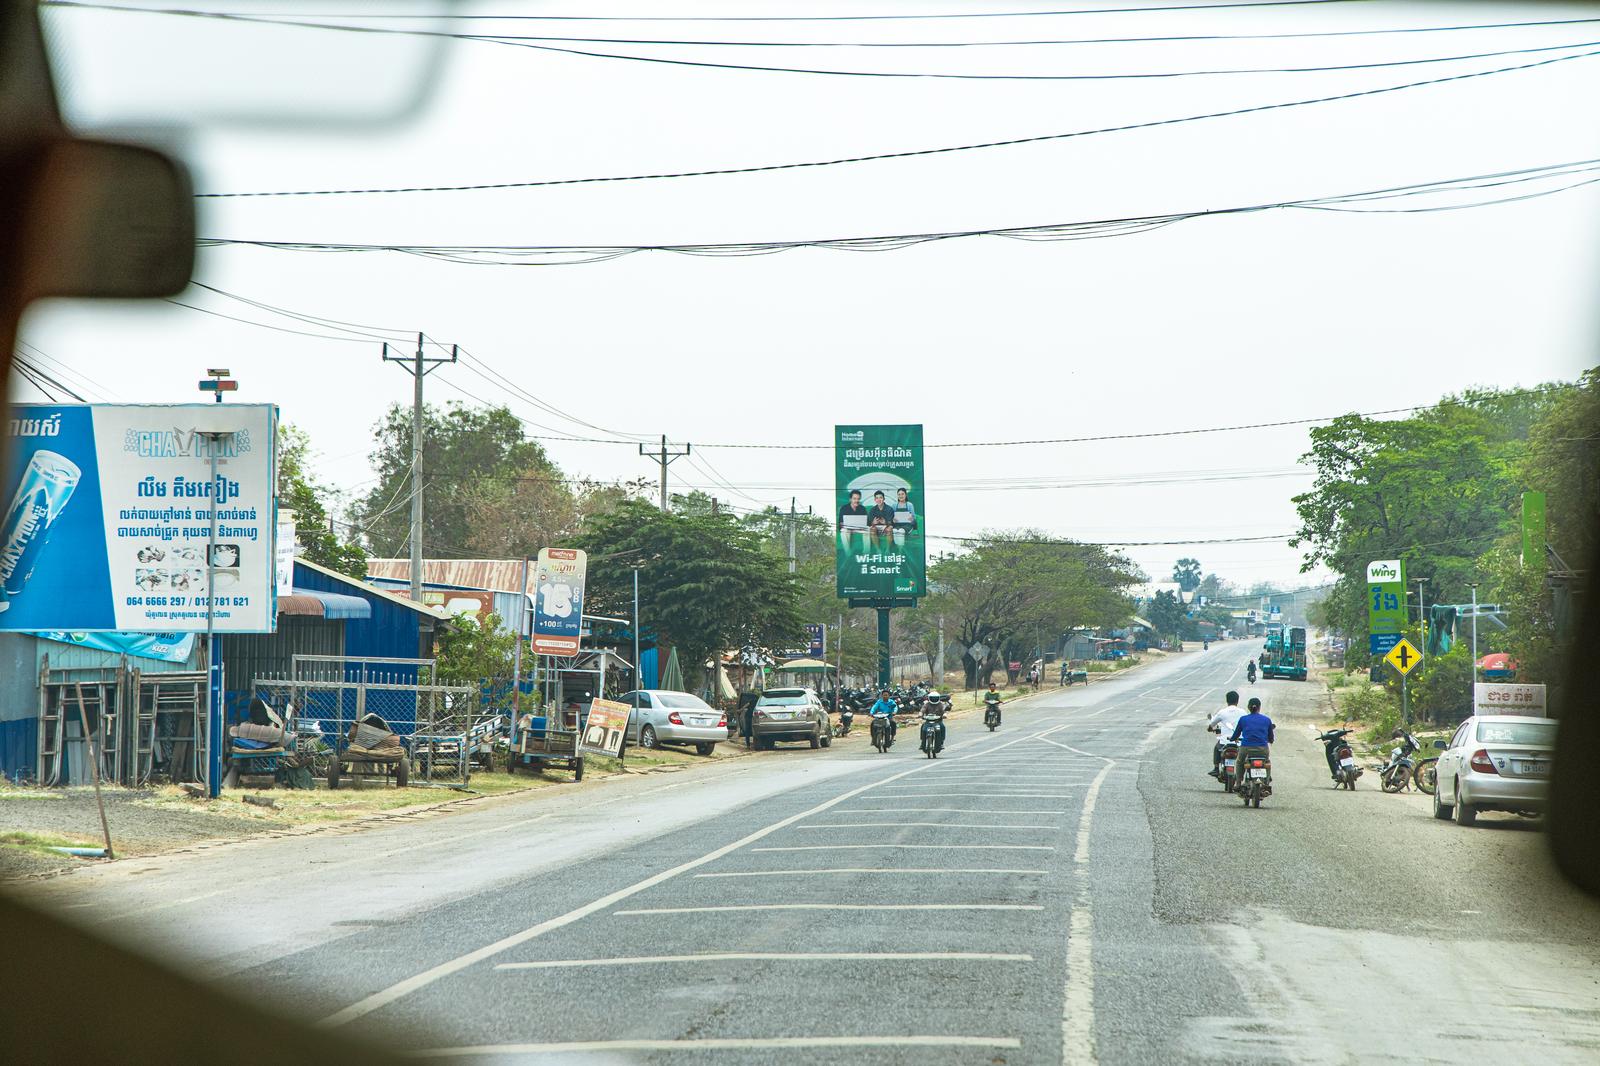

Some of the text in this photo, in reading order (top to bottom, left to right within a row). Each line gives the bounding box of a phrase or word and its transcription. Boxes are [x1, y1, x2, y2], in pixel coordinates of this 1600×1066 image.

[856, 554, 882, 563] Wi-Fi
[870, 566, 901, 574] Smart
[1371, 568, 1396, 579] Wing
[126, 597, 143, 606] 064
[145, 597, 167, 606] 6666
[170, 597, 186, 606] 297
[214, 597, 230, 606] 781
[233, 597, 249, 606] 621
